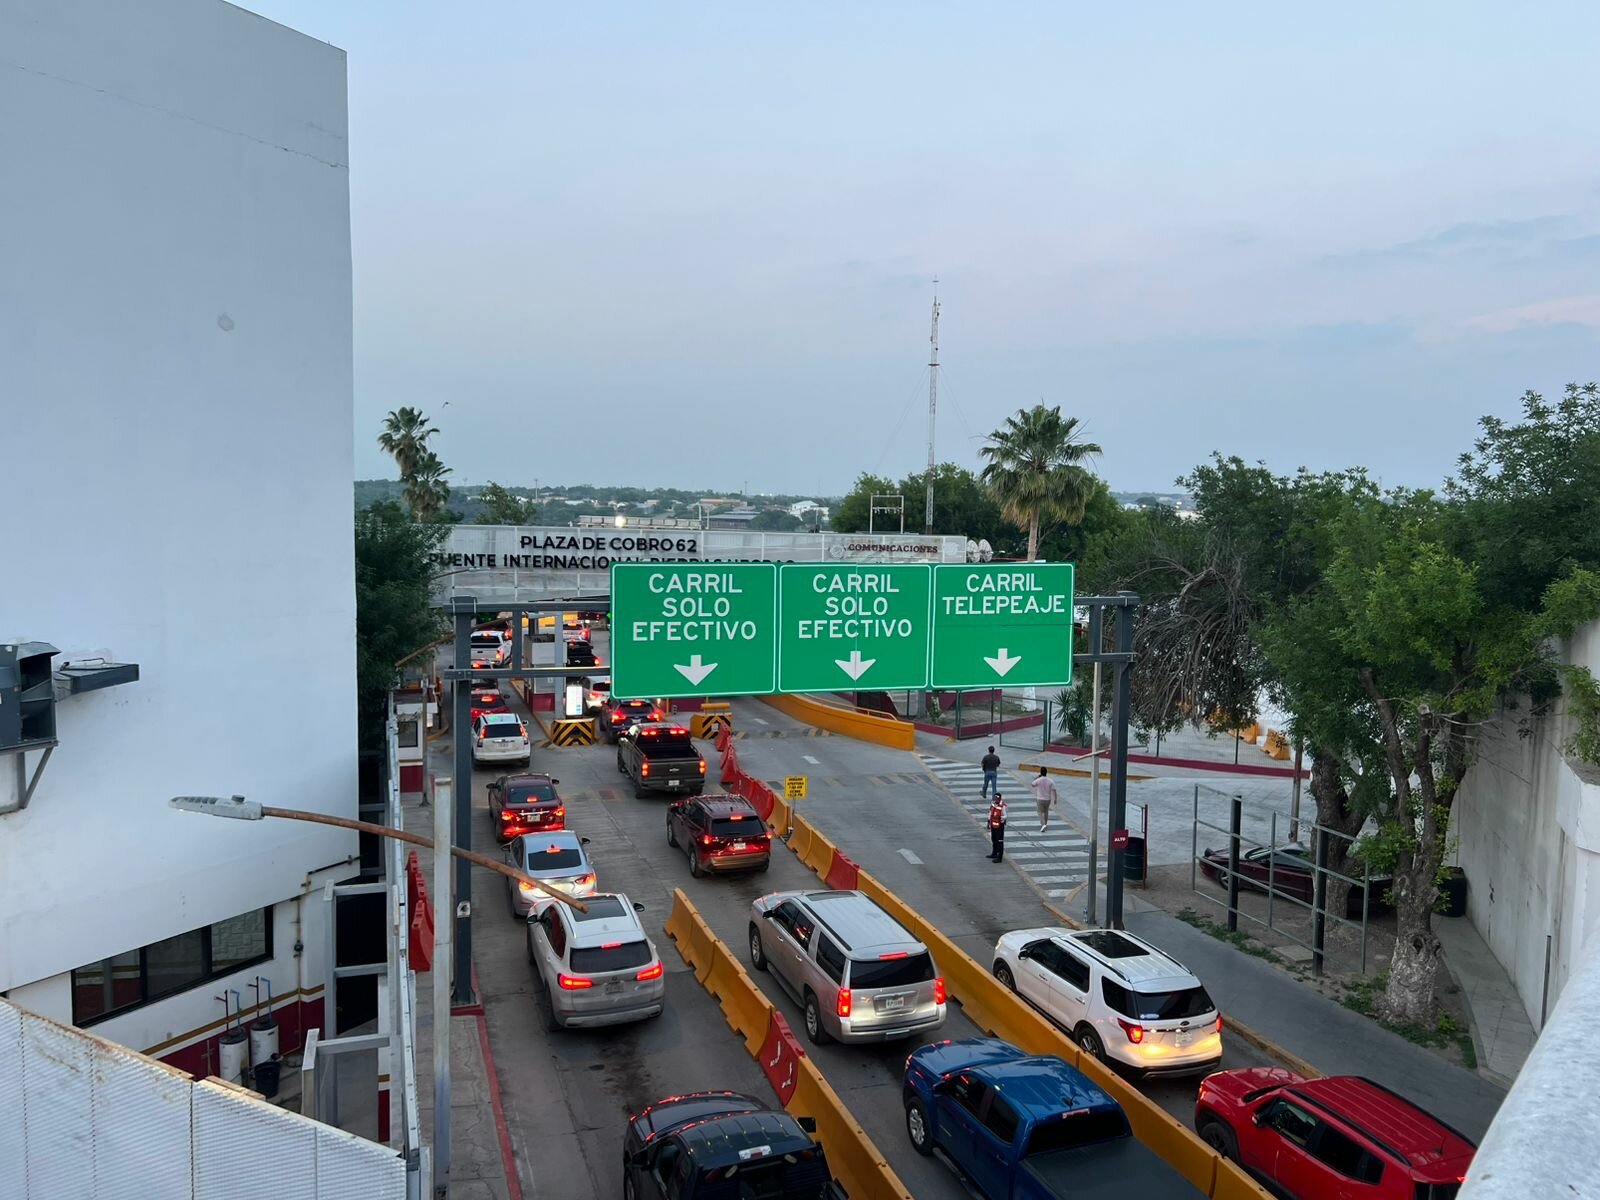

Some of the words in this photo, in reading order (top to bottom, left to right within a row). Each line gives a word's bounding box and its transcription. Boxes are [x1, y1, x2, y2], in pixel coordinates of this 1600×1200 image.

[520, 535, 580, 550] PLAZA
[582, 537, 606, 551] DE
[609, 537, 674, 552] COBRO
[675, 538, 697, 553] 62
[848, 543, 938, 553] COMUNICACIONES
[648, 573, 743, 594] CARRIL
[812, 573, 900, 593] CARRIL
[966, 573, 1043, 593] CARRIL
[661, 597, 730, 618] SOLO
[824, 596, 888, 616] SOLO
[942, 594, 1065, 615] TELEPEAJE
[632, 620, 757, 641] EFECTIVO
[798, 618, 913, 639] EFECTIVO
